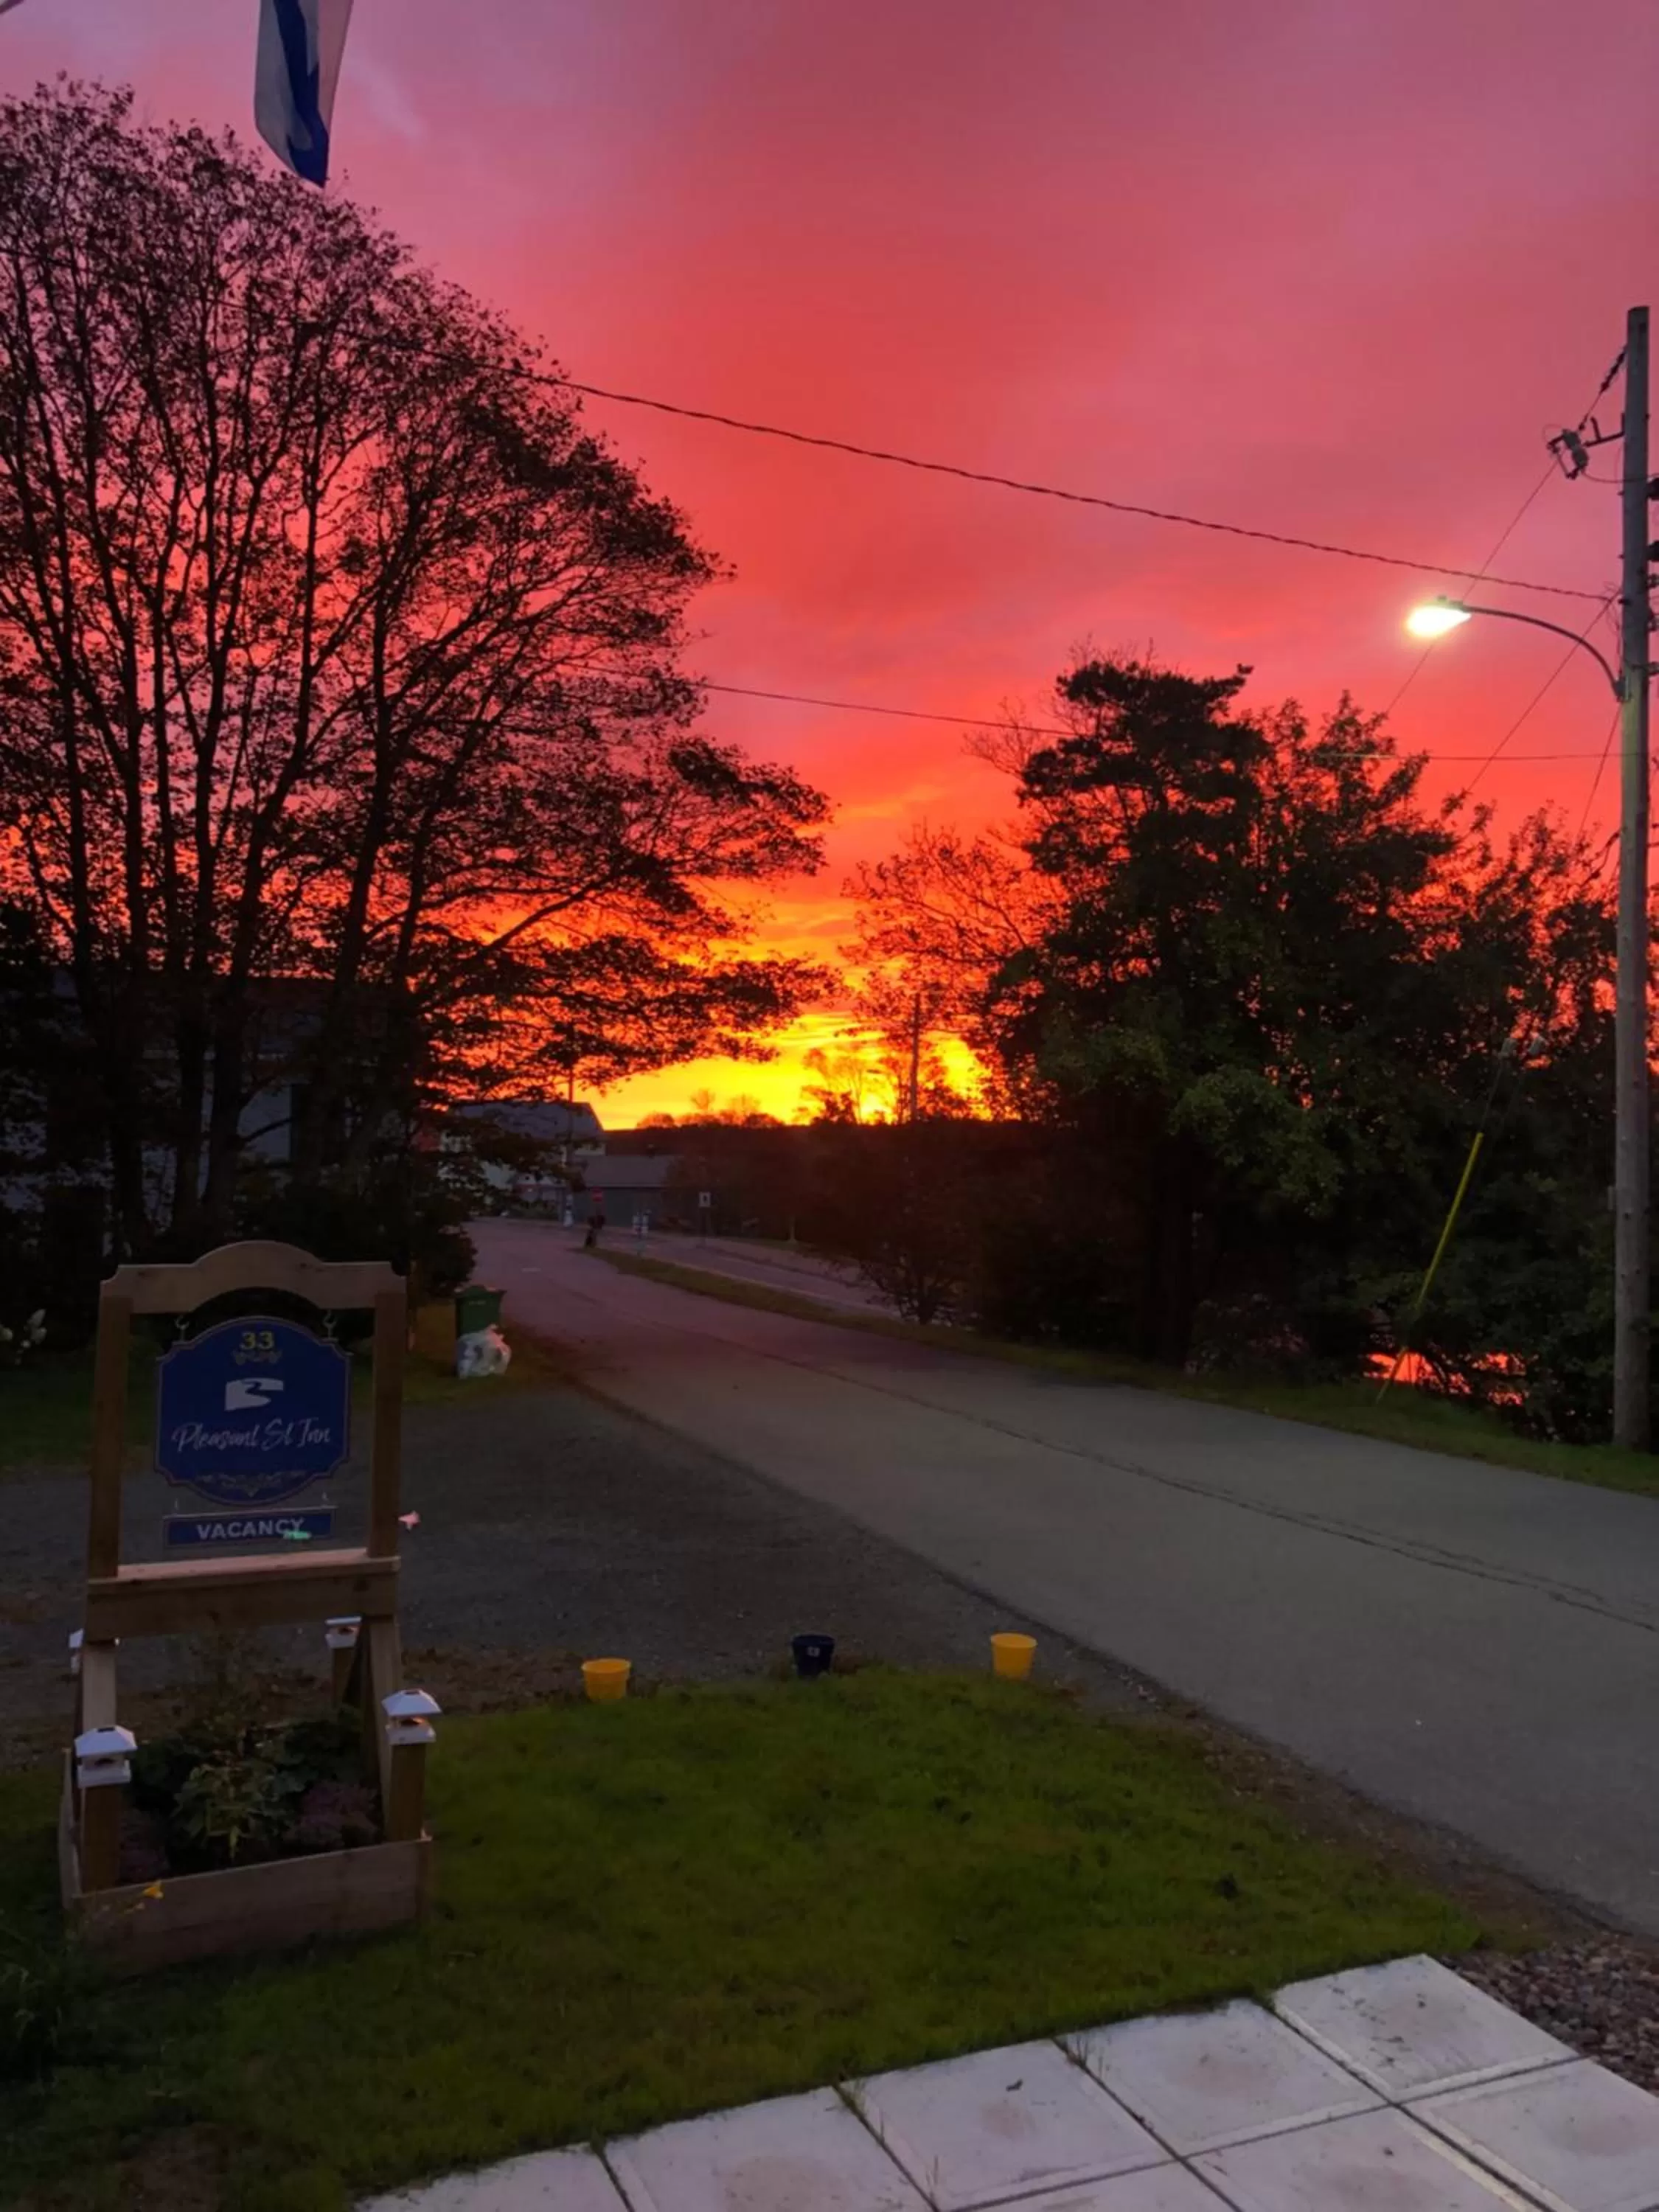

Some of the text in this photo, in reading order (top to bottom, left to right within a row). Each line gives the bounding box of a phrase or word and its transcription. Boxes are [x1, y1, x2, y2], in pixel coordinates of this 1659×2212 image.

[240, 1331, 276, 1350] 33
[171, 1417, 331, 1452] Pleasant St Inn
[196, 1517, 305, 1540] VACANCY
